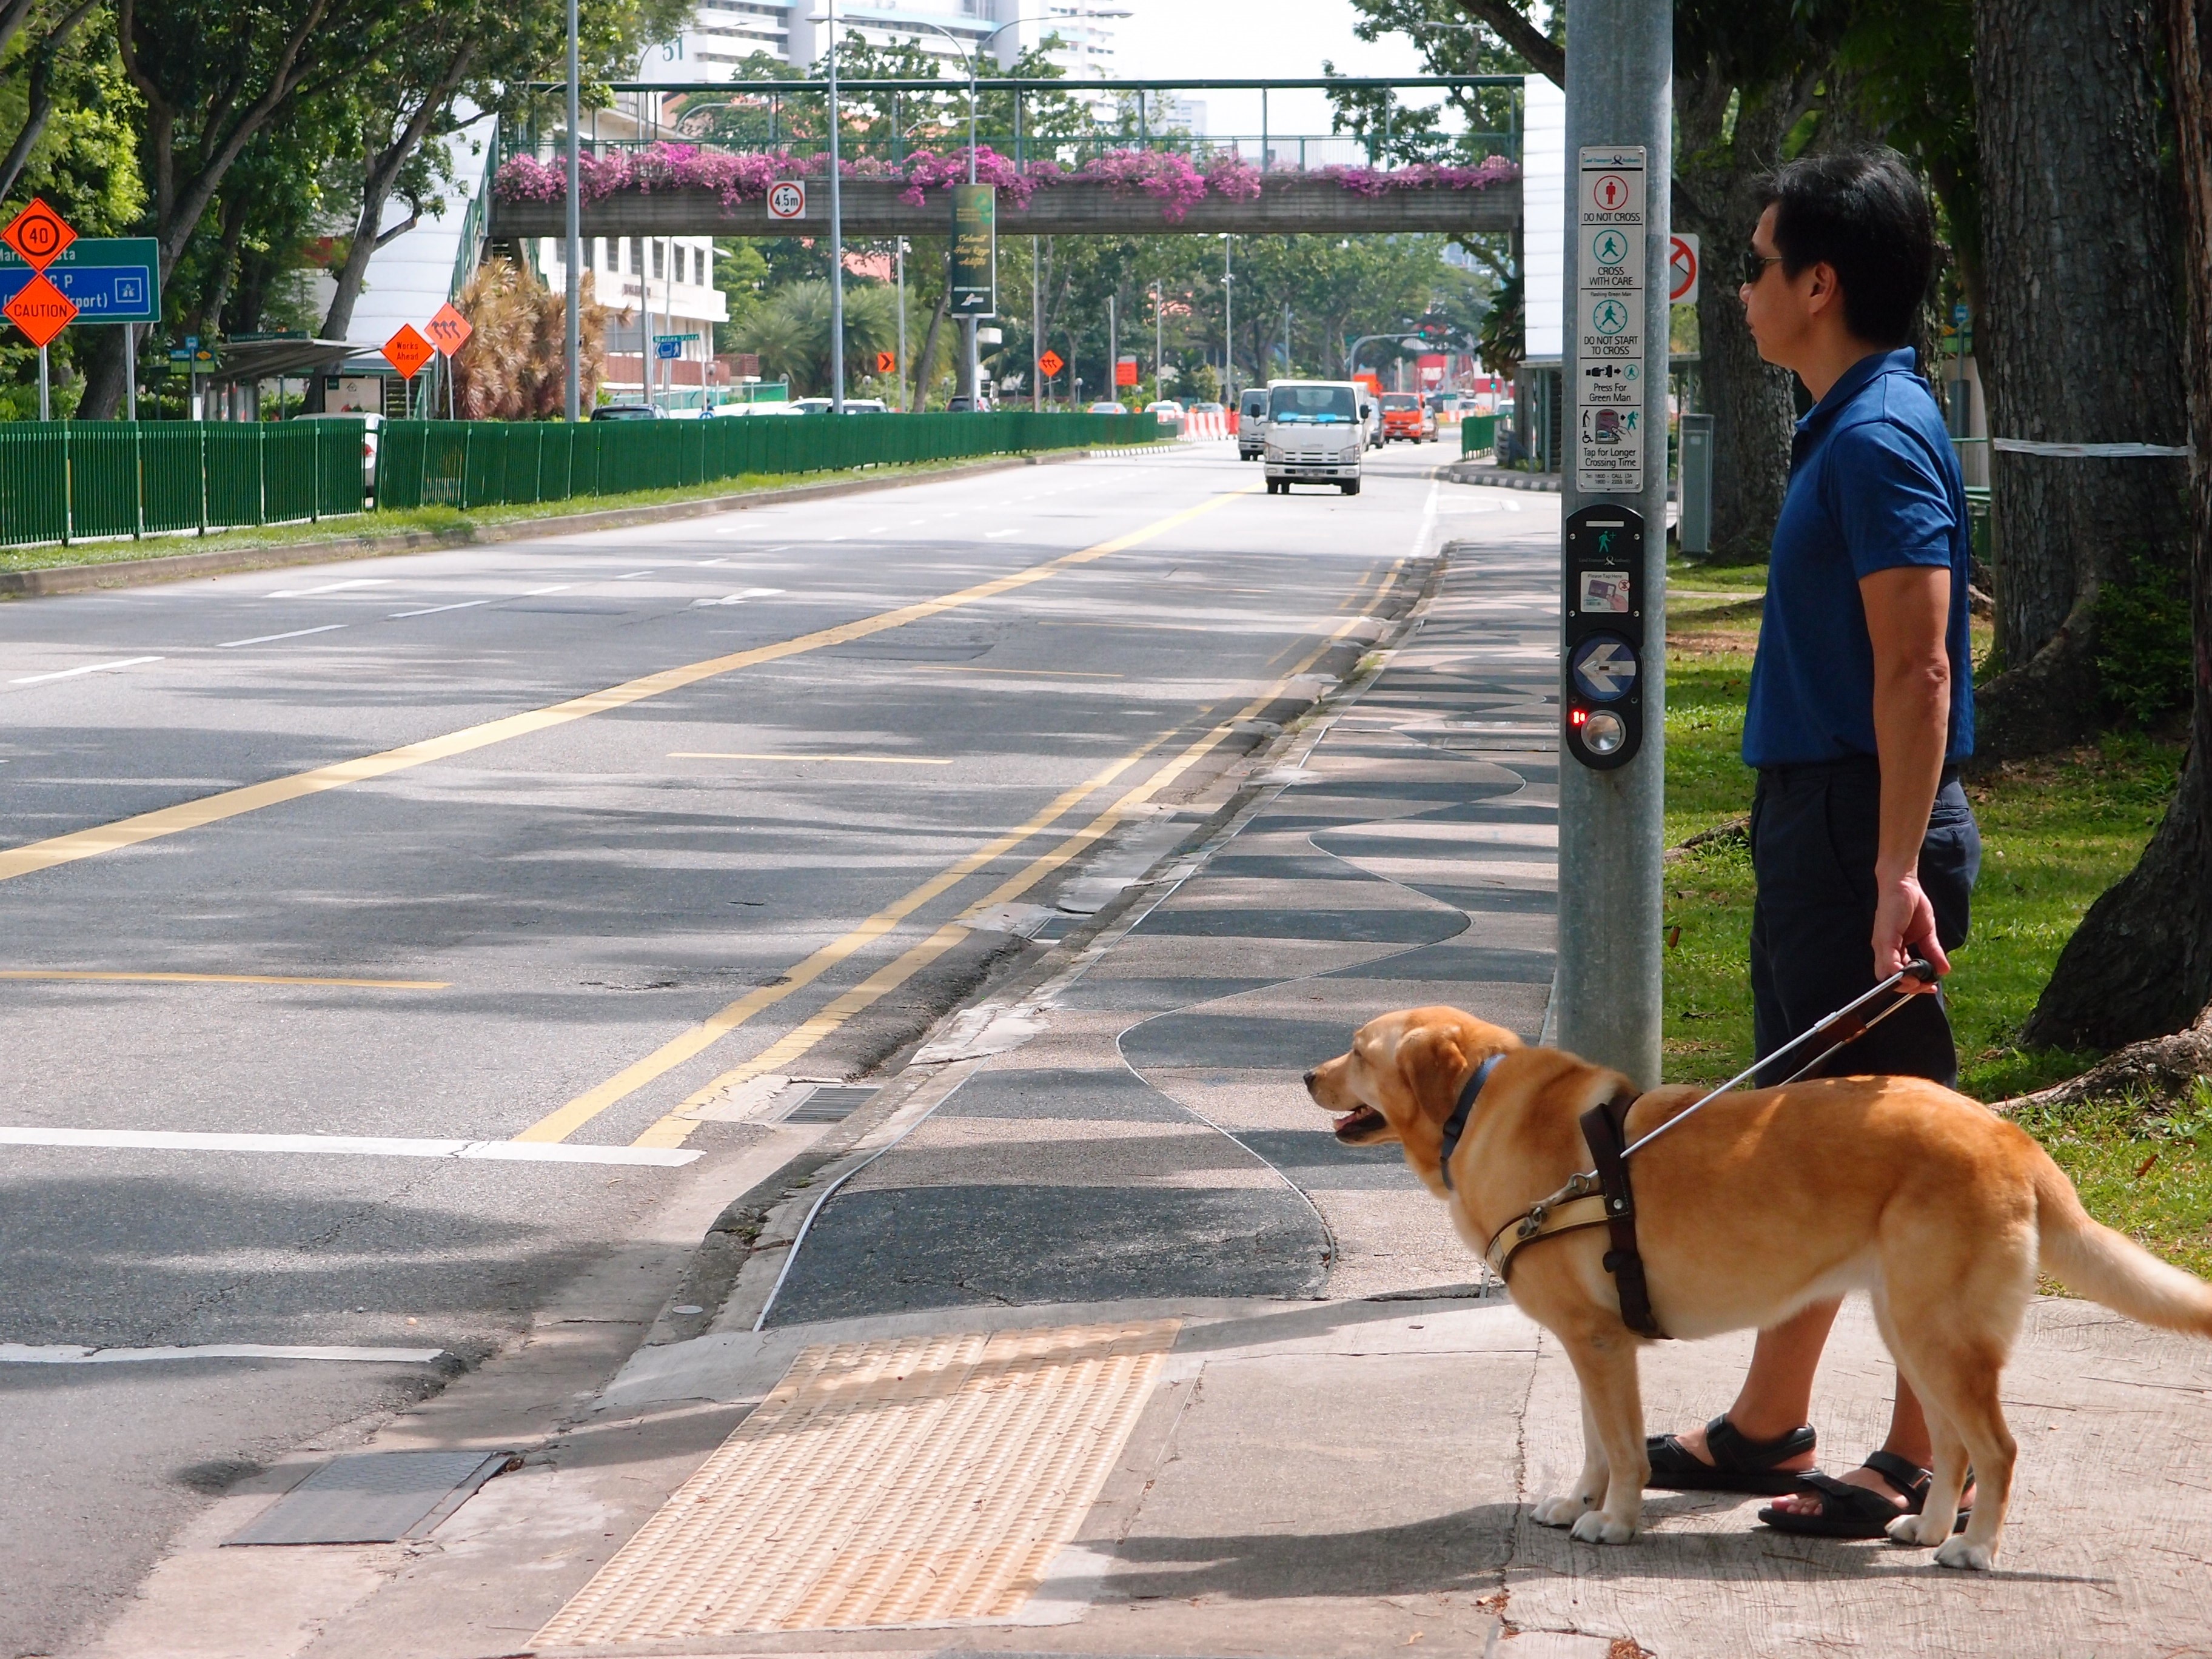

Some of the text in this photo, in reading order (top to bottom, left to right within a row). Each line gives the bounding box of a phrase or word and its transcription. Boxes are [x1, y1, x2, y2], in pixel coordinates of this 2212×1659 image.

[662, 35, 683, 61] 51
[775, 194, 799, 206] 4.5m
[1584, 212, 1640, 221] DO NOT CROSS
[29, 227, 48, 244] 40
[1598, 267, 1624, 275] CROSS
[1589, 276, 1633, 286] WITH CARE
[14, 304, 67, 317] CAUTION
[1584, 336, 1638, 344] DO NOT START
[1591, 346, 1629, 355] TO CROSS
[397, 352, 418, 360] Ahead
[1594, 383, 1627, 392] Press For
[1589, 393, 1631, 401] Green Man
[1584, 447, 1636, 458] Tap for Longer
[1585, 457, 1637, 468] Crossing Time
